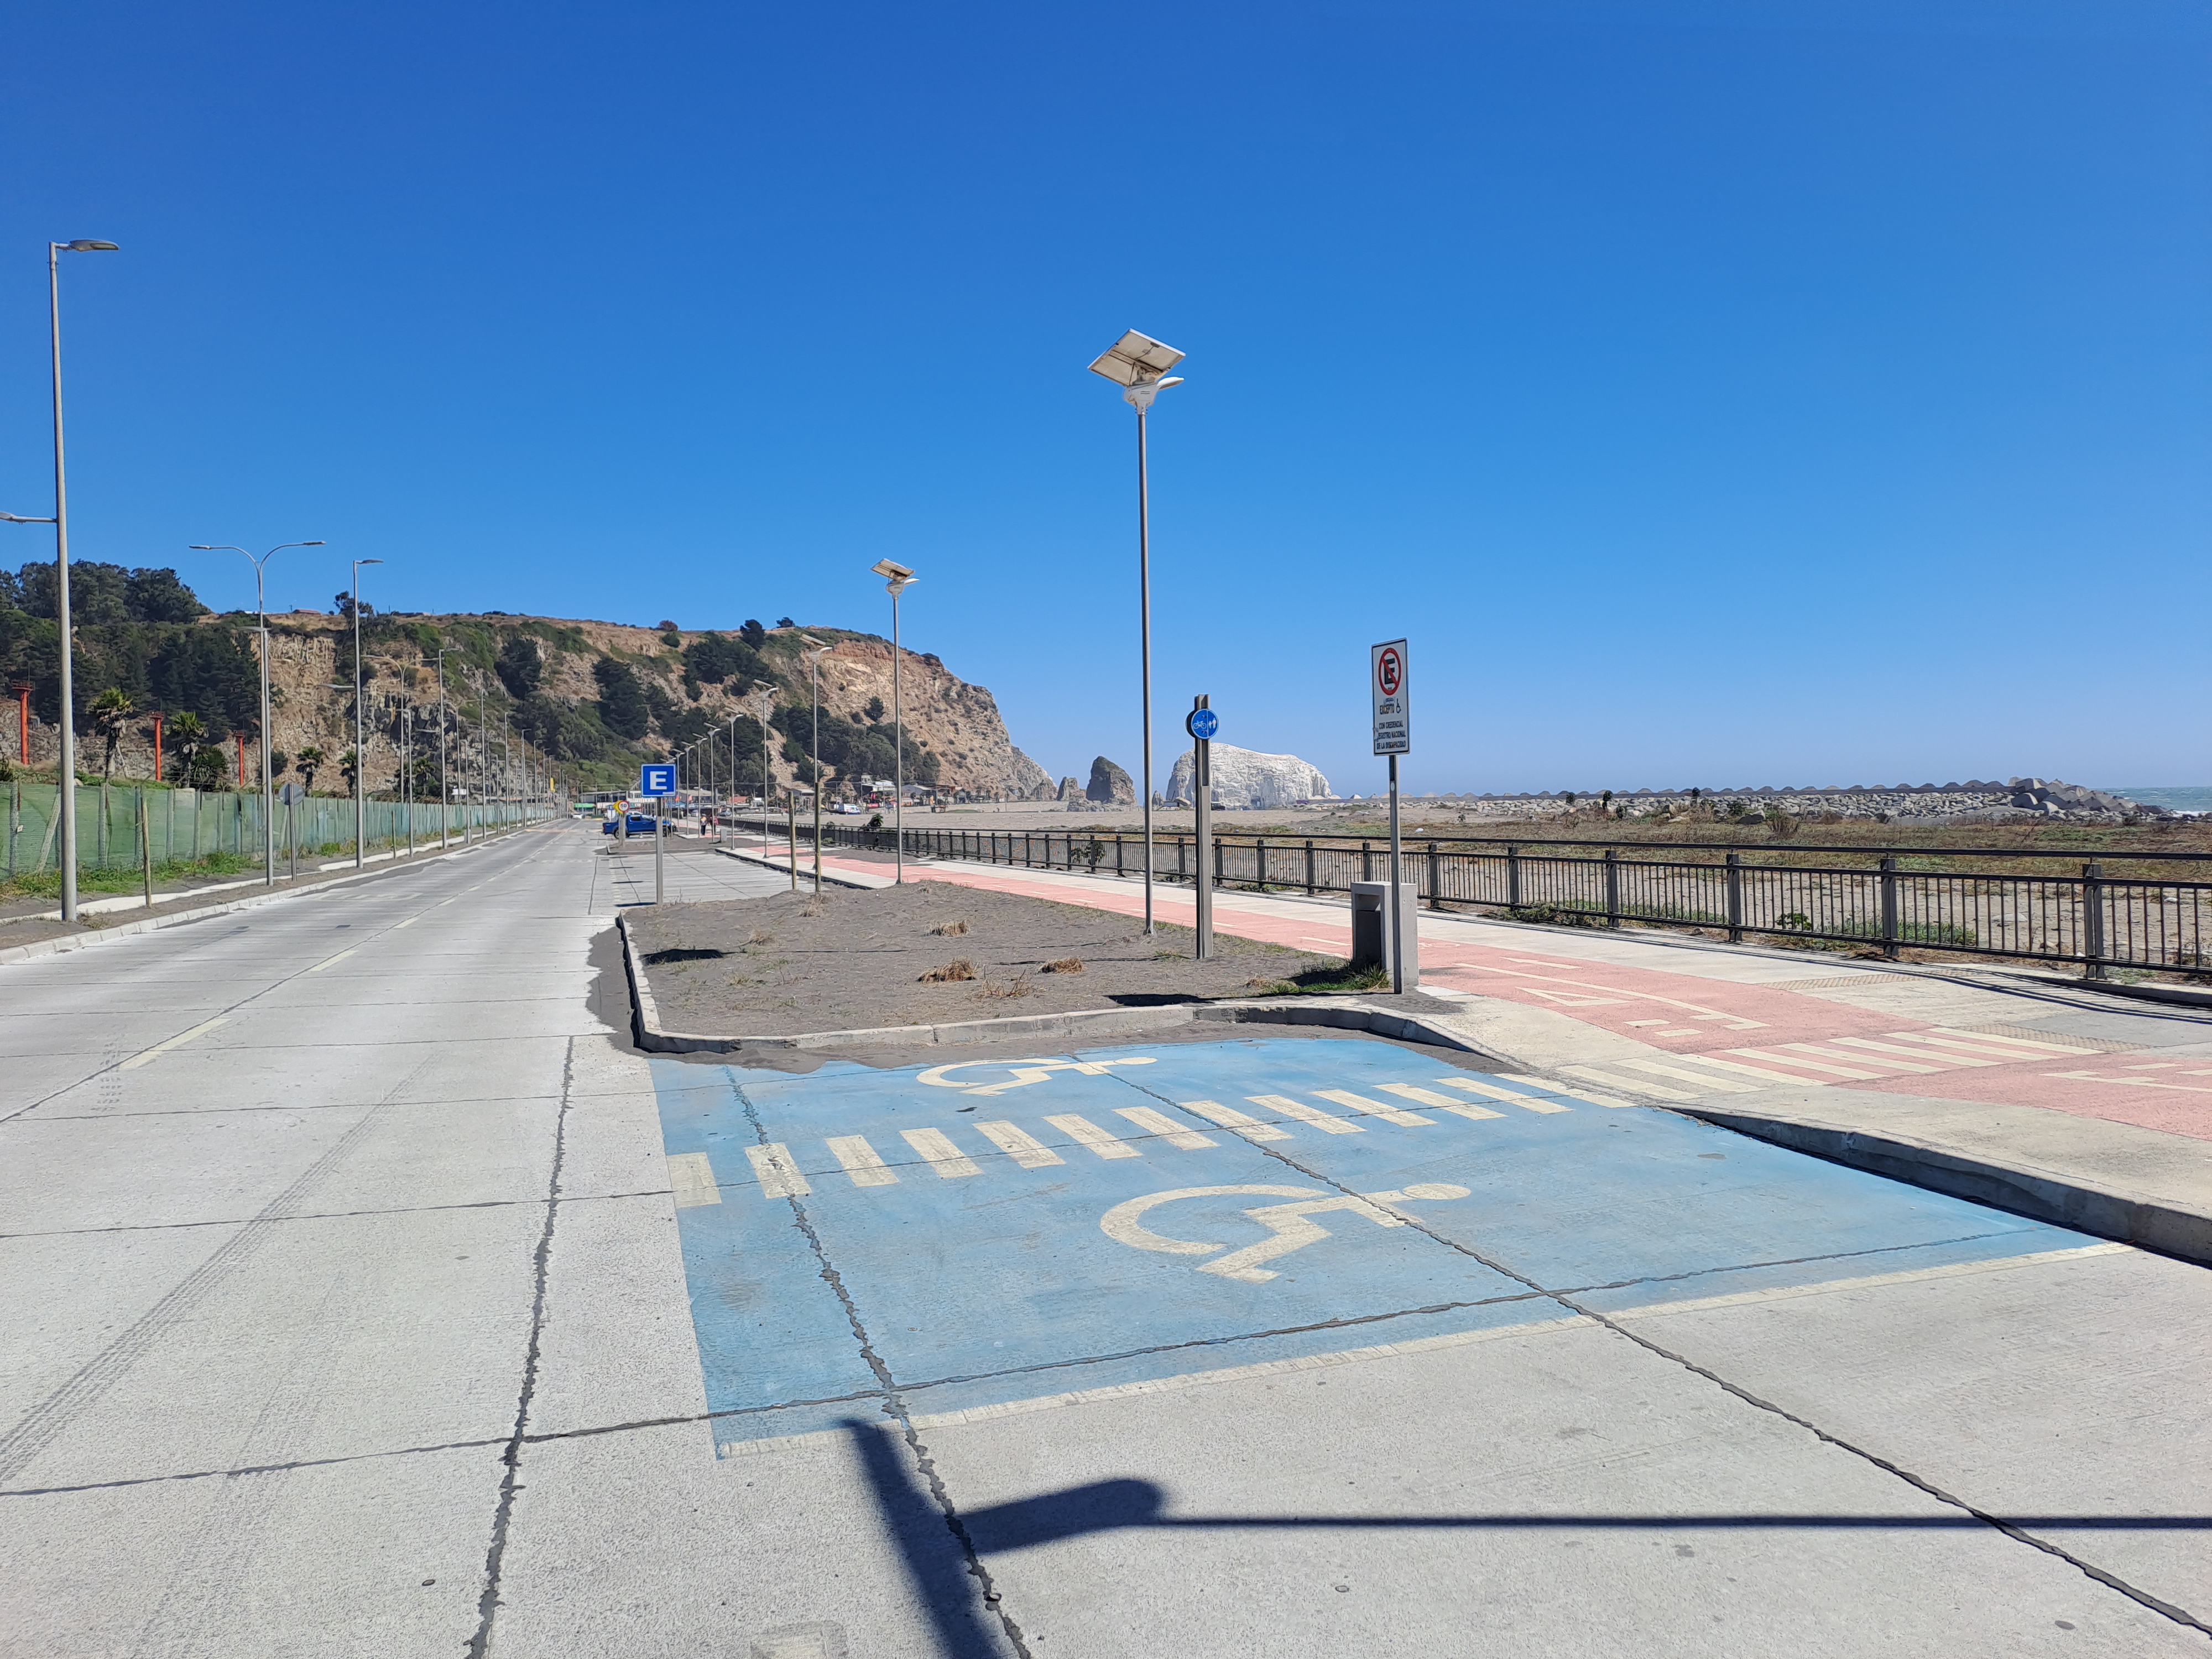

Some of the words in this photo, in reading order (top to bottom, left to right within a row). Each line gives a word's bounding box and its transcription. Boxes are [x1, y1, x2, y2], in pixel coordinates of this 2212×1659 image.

[1384, 658, 1395, 685] E
[1380, 703, 1394, 714] EXCEPTO
[1386, 720, 1403, 728] CREDENCIAL
[1391, 730, 1406, 738] NACIONAL
[650, 771, 667, 790] E
